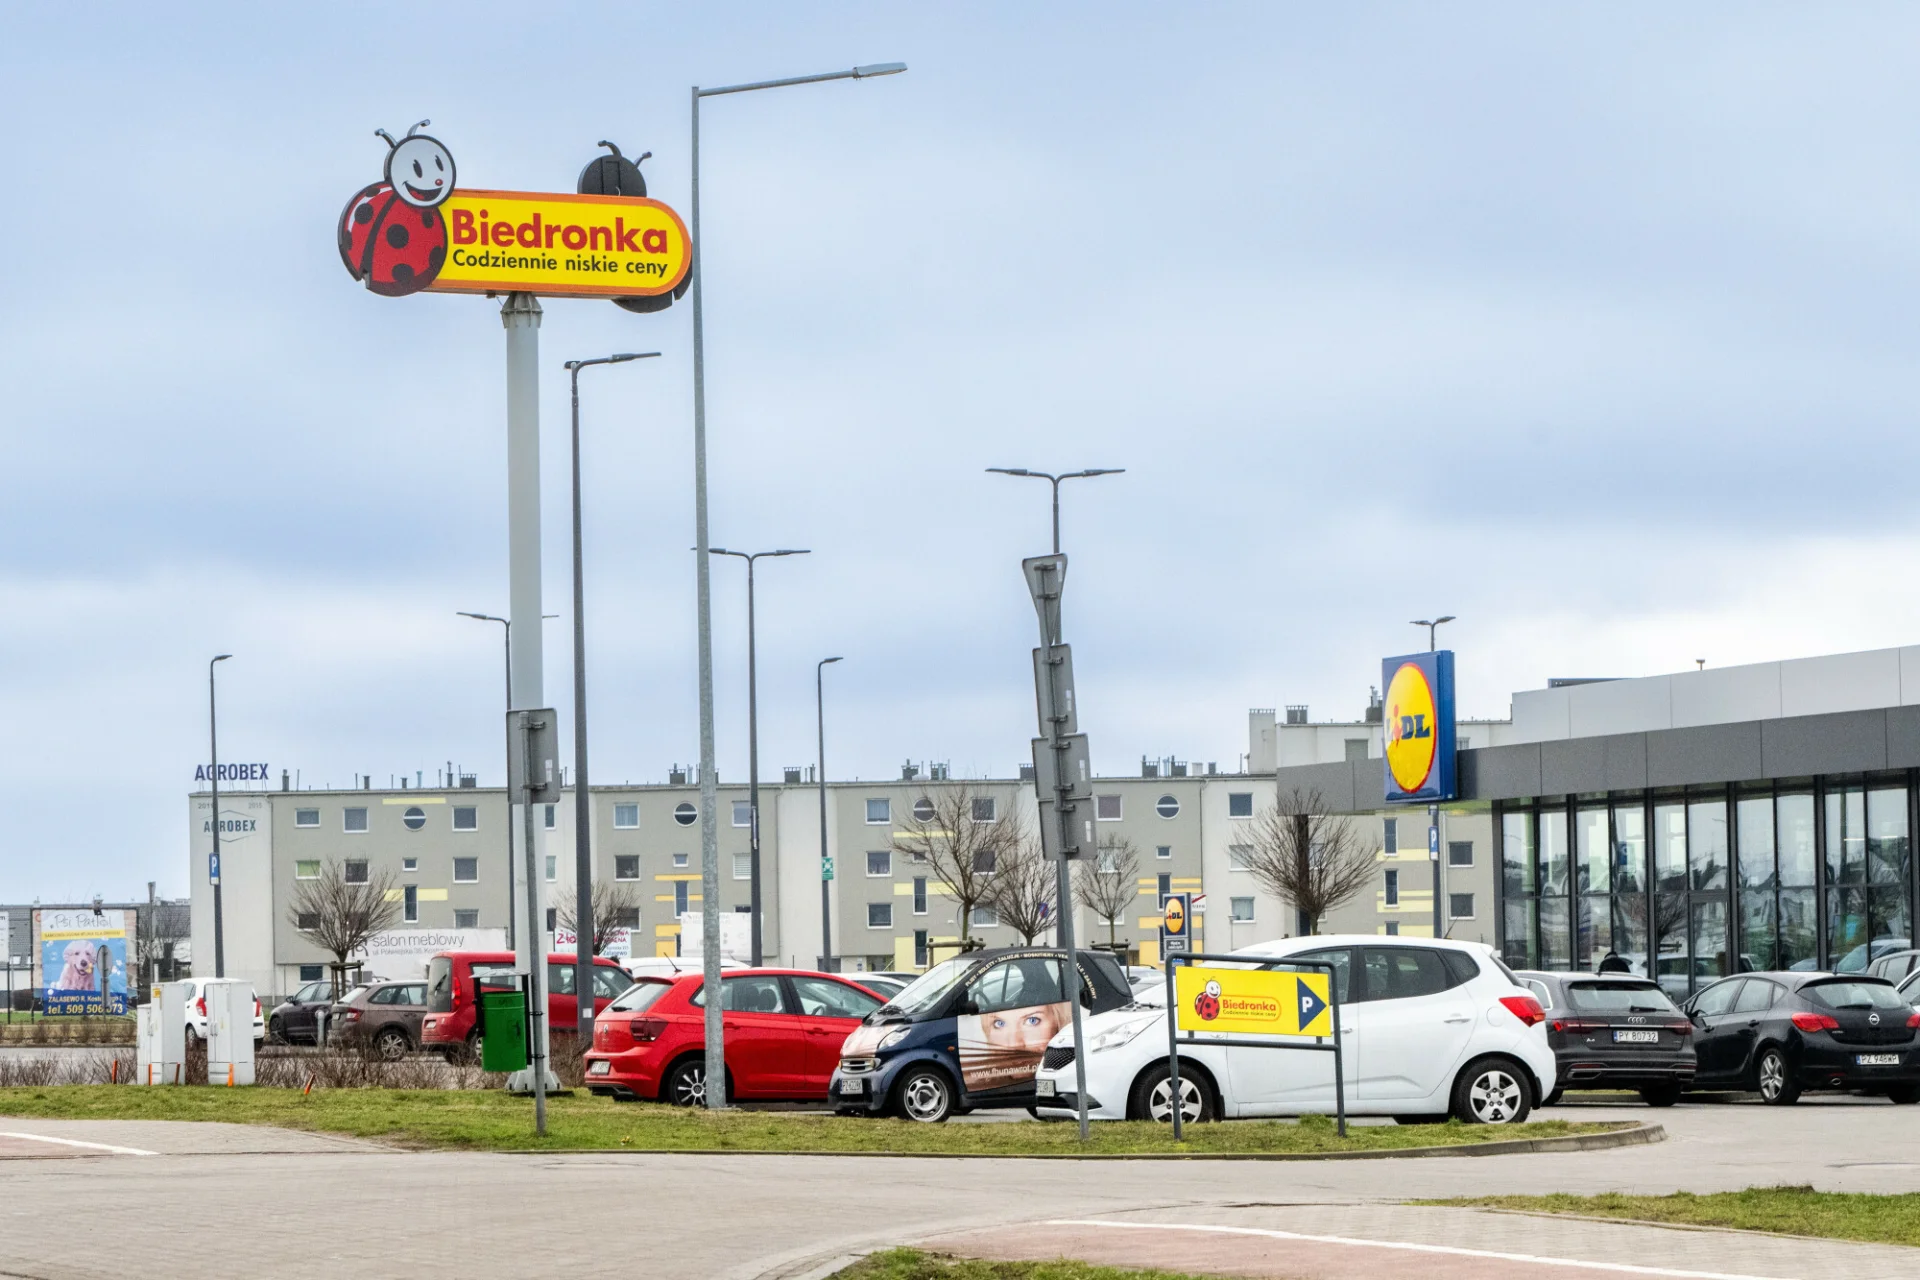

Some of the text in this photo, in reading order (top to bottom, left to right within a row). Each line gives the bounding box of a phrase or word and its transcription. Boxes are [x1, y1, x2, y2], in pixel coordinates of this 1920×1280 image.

[452, 209, 668, 254] Biedronka
[453, 249, 668, 278] Codziennie niskie ceny
[204, 820, 256, 833] AROBEX
[212, 856, 217, 873] P
[372, 933, 465, 948] salon meblowy
[48, 1004, 63, 1014] tel.
[67, 1004, 83, 1014] 509
[1223, 997, 1313, 1012] Biedronka P
[1632, 1031, 1657, 1041] 80732
